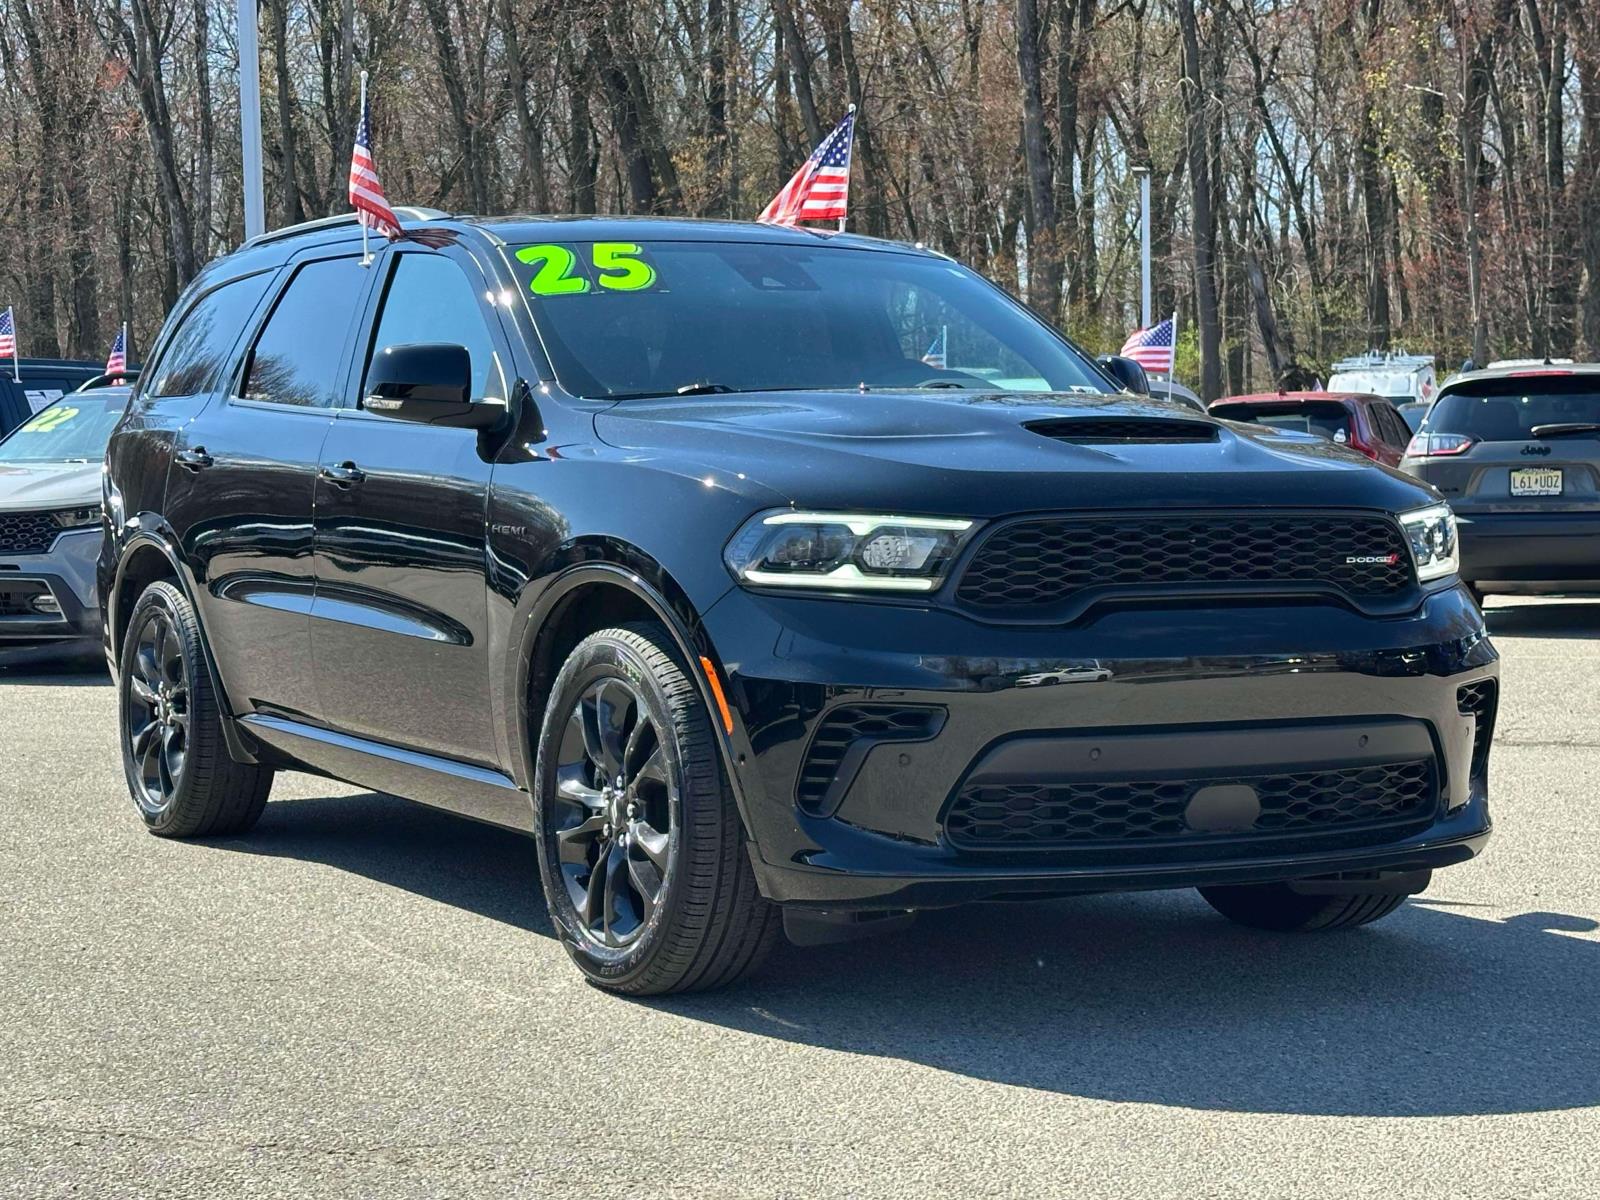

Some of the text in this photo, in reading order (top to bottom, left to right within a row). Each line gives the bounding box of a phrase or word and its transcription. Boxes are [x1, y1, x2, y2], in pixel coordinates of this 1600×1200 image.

[515, 243, 656, 295] 25
[20, 407, 79, 433] 22
[1520, 445, 1552, 456] Jeep
[491, 524, 527, 536] HEMI
[1346, 556, 1392, 564] DODGE
